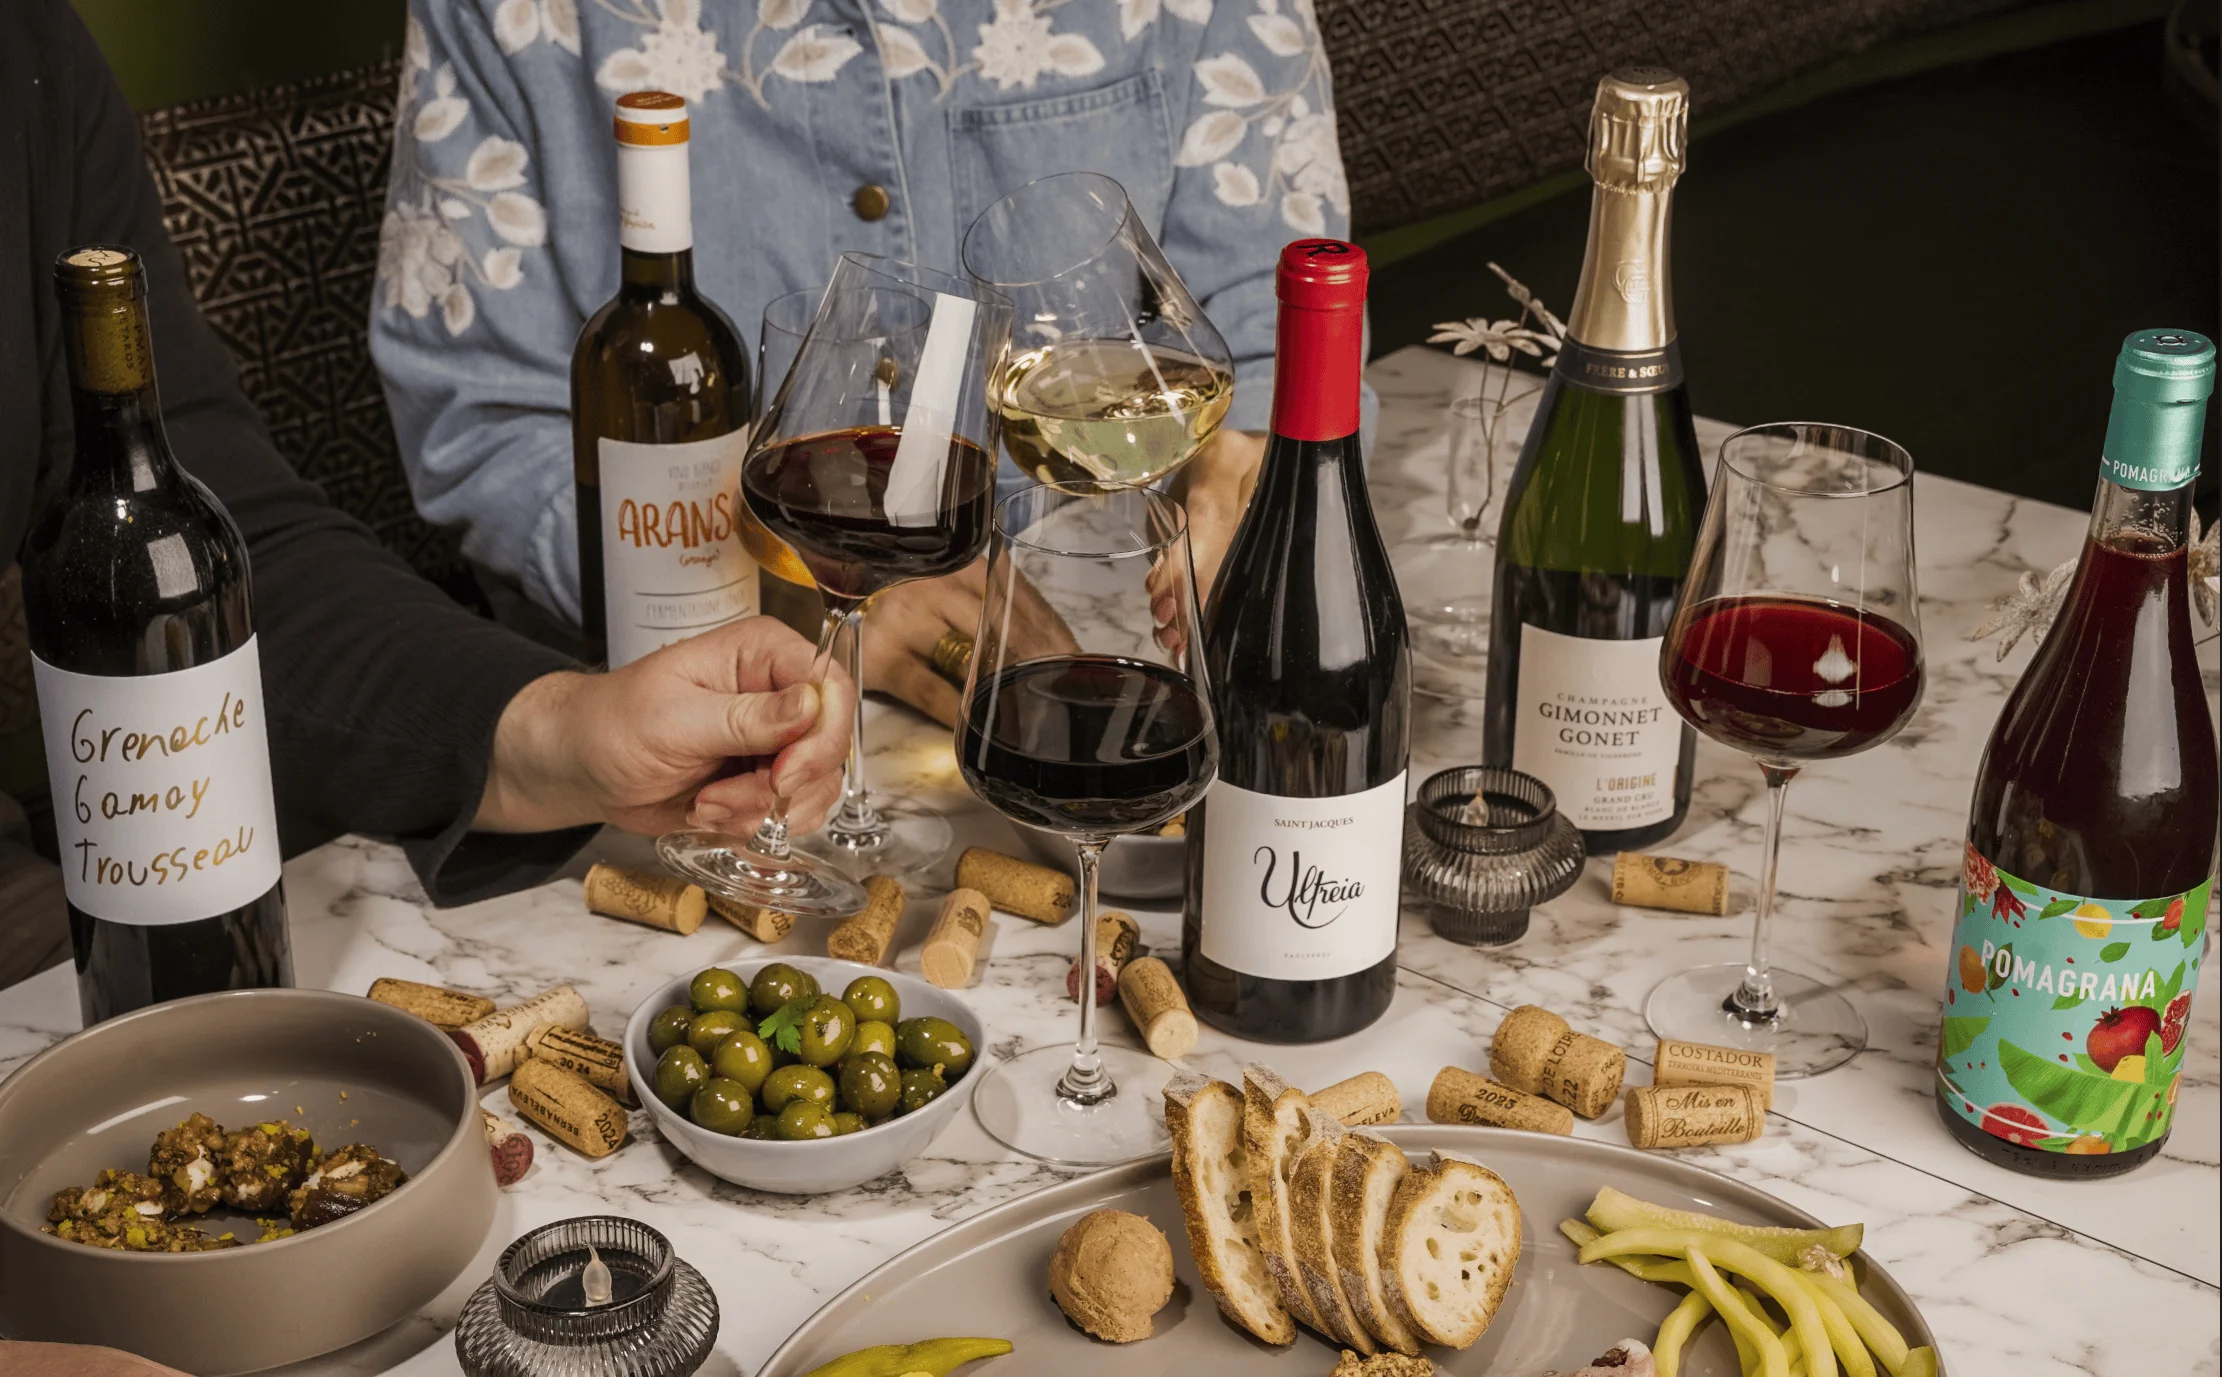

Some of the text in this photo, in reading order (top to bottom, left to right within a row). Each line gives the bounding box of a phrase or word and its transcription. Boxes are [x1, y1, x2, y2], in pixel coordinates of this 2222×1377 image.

[1628, 368, 1638, 379] &
[618, 492, 737, 549] ARANS
[1557, 692, 1648, 706] CHAMPAGNE
[1539, 702, 1662, 726] GIMONNET
[71, 691, 245, 763] Grenache
[1559, 728, 1640, 746] GONET
[1596, 772, 1657, 791] L'ORIGINE
[75, 774, 210, 824] Gamay
[1593, 796, 1631, 804] GRAND
[1274, 817, 1354, 830] SAINT JACQUES
[75, 825, 254, 886] Trousseau
[1254, 846, 1365, 929] Ultreia
[1980, 939, 2156, 1001] POMAGRANA
[560, 1057, 590, 1075] 30 24
[1669, 1043, 1764, 1069] COSTADOR
[1543, 1066, 1556, 1088] DE
[1476, 1088, 1518, 1110] 2023
[1666, 1091, 1736, 1121] Mis en
[510, 1087, 580, 1137] BERNABELEVA
[594, 1112, 620, 1152] 2024
[1661, 1117, 1746, 1139] Bouteille
